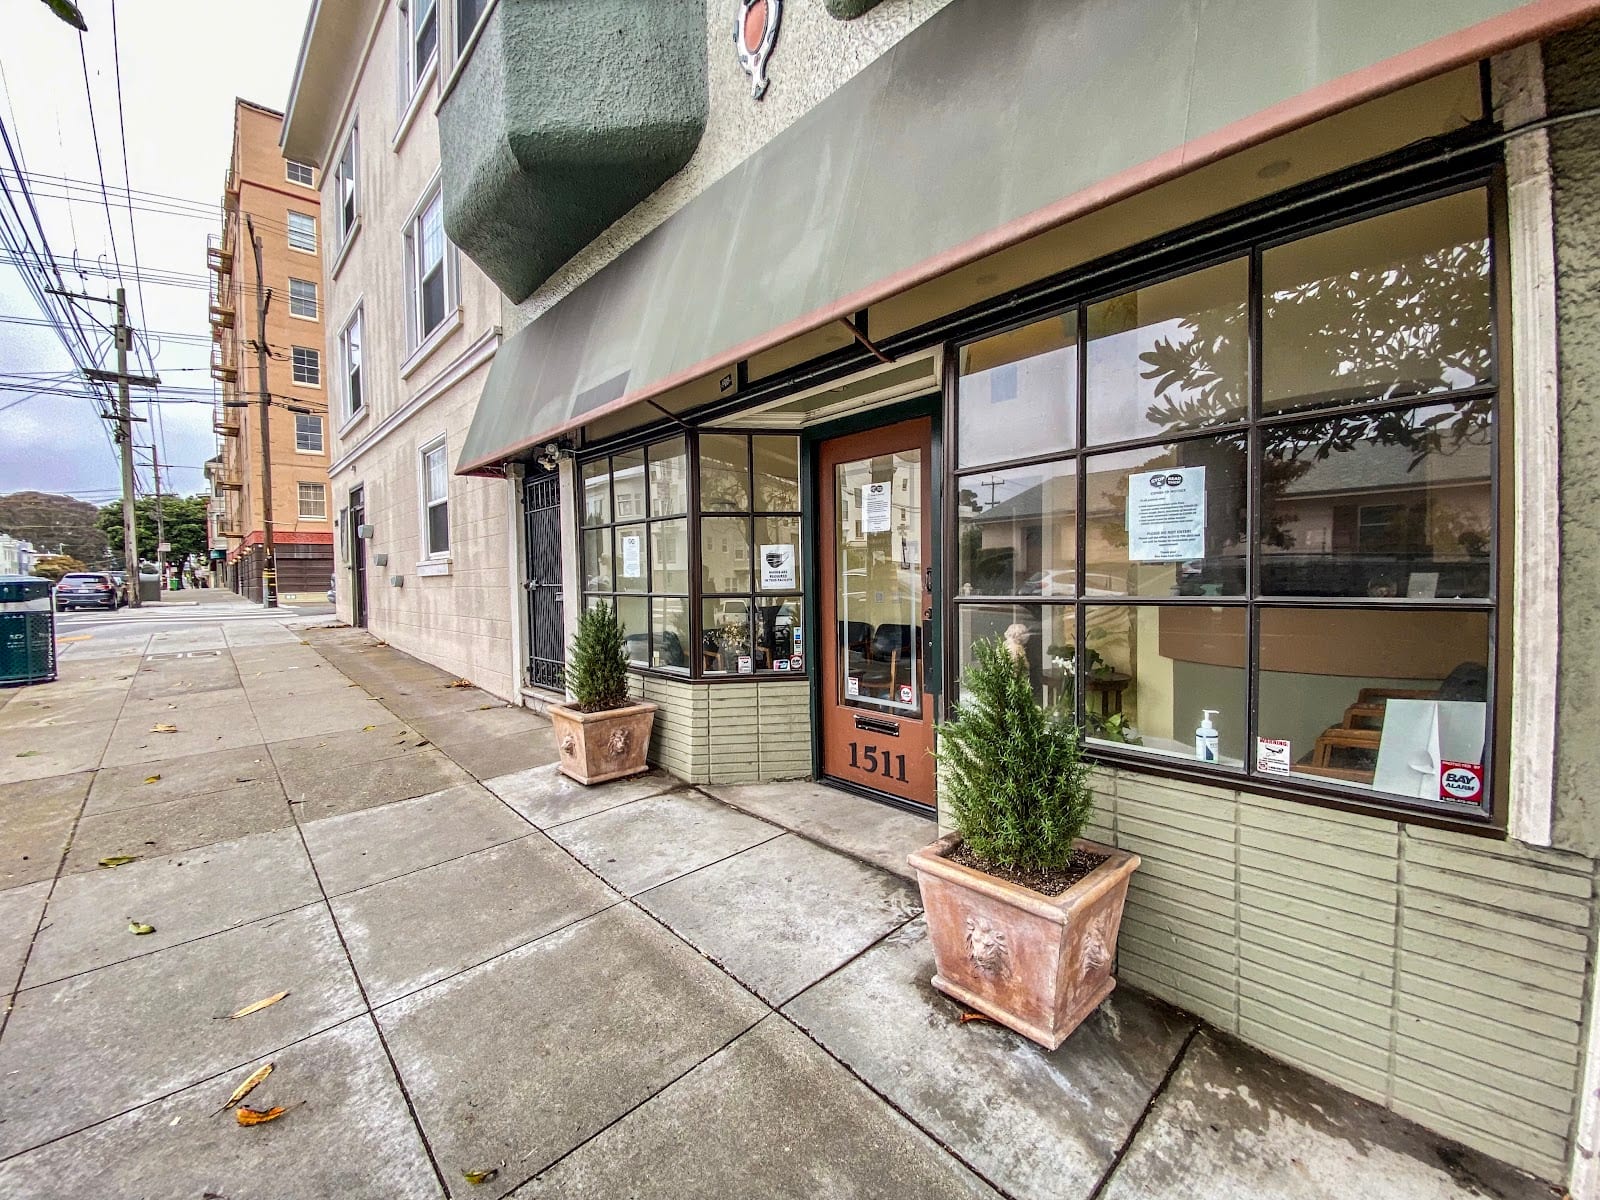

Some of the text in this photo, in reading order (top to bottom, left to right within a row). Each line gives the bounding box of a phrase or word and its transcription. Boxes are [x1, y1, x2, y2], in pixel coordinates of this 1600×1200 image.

[848, 742, 909, 783] 1511
[1446, 773, 1476, 784] BAY
[1445, 783, 1474, 791] ALARM
